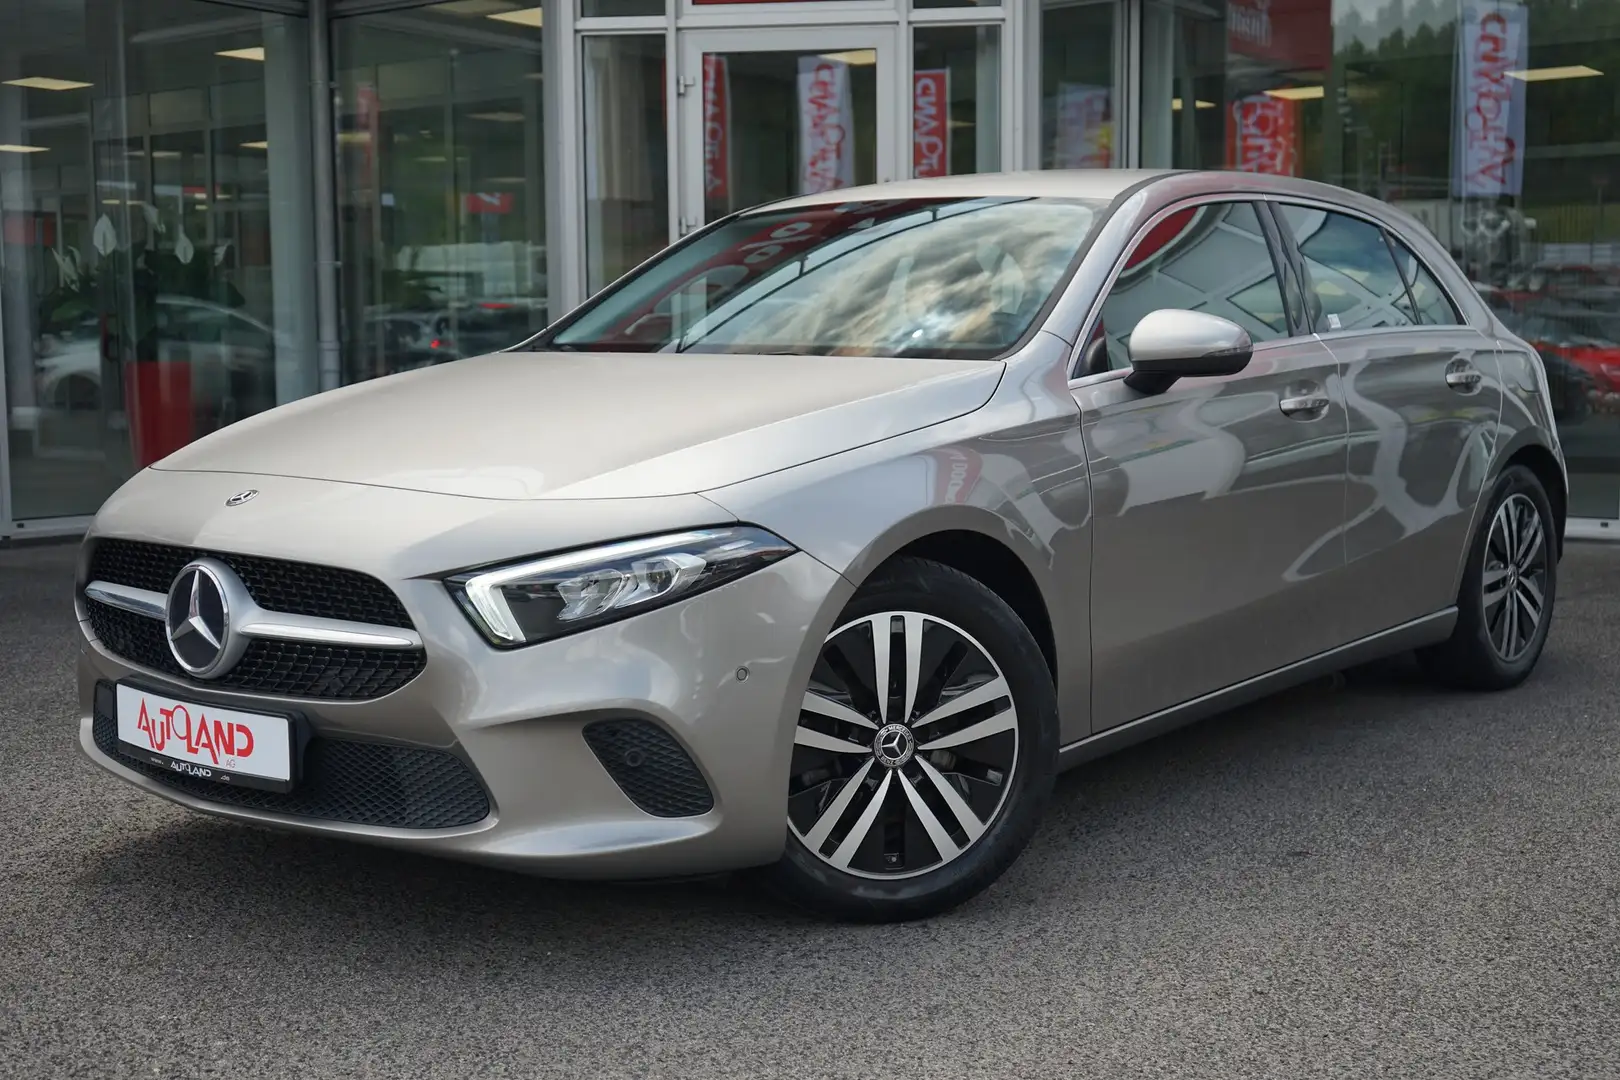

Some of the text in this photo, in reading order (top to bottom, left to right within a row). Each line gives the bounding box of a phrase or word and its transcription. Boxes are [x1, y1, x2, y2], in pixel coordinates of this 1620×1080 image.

[137, 697, 254, 765] AUTOLAND
[170, 761, 212, 777] AUTOLAND
[225, 758, 236, 769] AG
